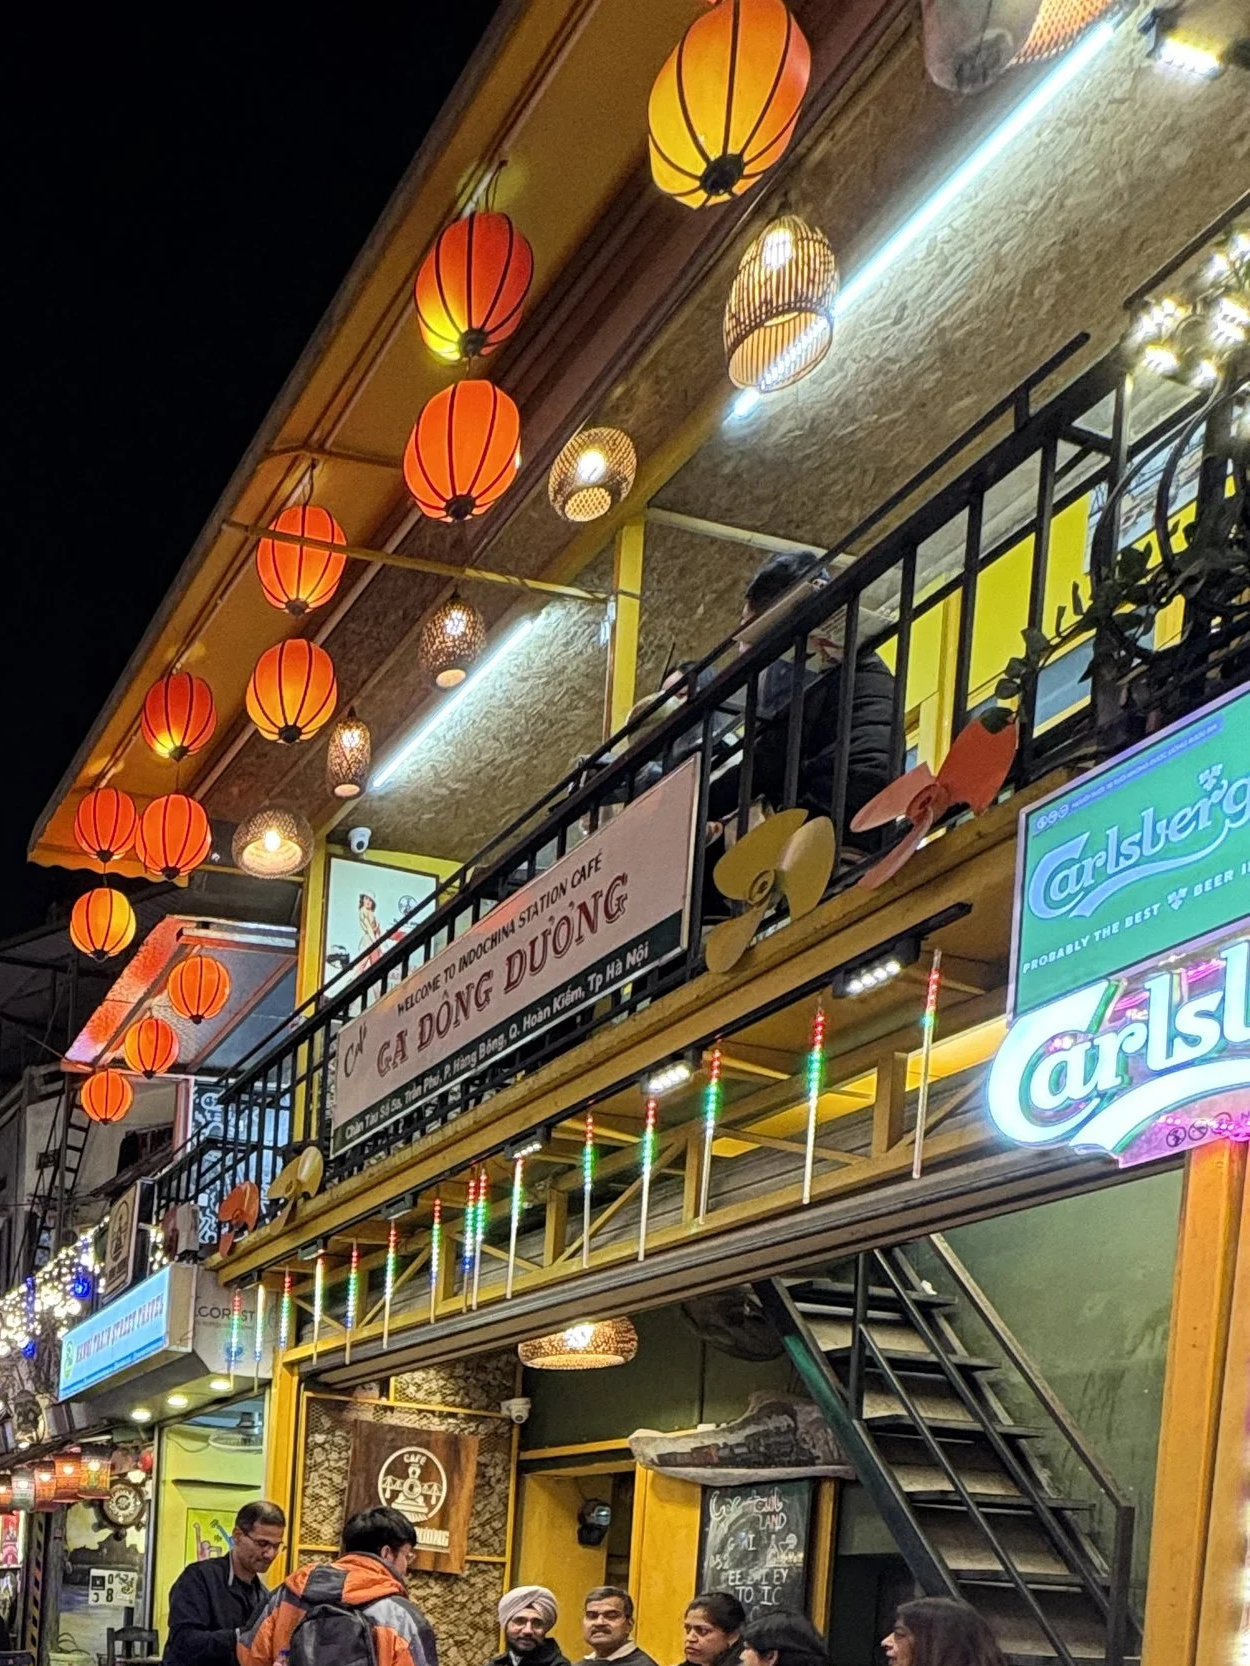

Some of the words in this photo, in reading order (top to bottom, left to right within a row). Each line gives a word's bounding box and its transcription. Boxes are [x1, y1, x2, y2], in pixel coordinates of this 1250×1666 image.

[1028, 777, 1250, 919] Carlsberg
[376, 1029, 409, 1077] GA
[503, 872, 628, 994] DƯƠNG
[398, 973, 442, 1015] WELCOME
[443, 962, 456, 985] TO
[458, 919, 516, 973] INDOCHINA
[517, 878, 569, 929] STATION
[1022, 935, 1091, 974] PROBABLY
[1094, 921, 1120, 943] THE
[1124, 903, 1162, 929] BEST
[1193, 870, 1235, 897] BEER
[443, 1063, 452, 1081] P.
[509, 1022, 521, 1040] Q.
[523, 1005, 551, 1033] Hoàn
[587, 971, 604, 993] Tp
[606, 960, 623, 983] Hà
[626, 941, 649, 970] Nội
